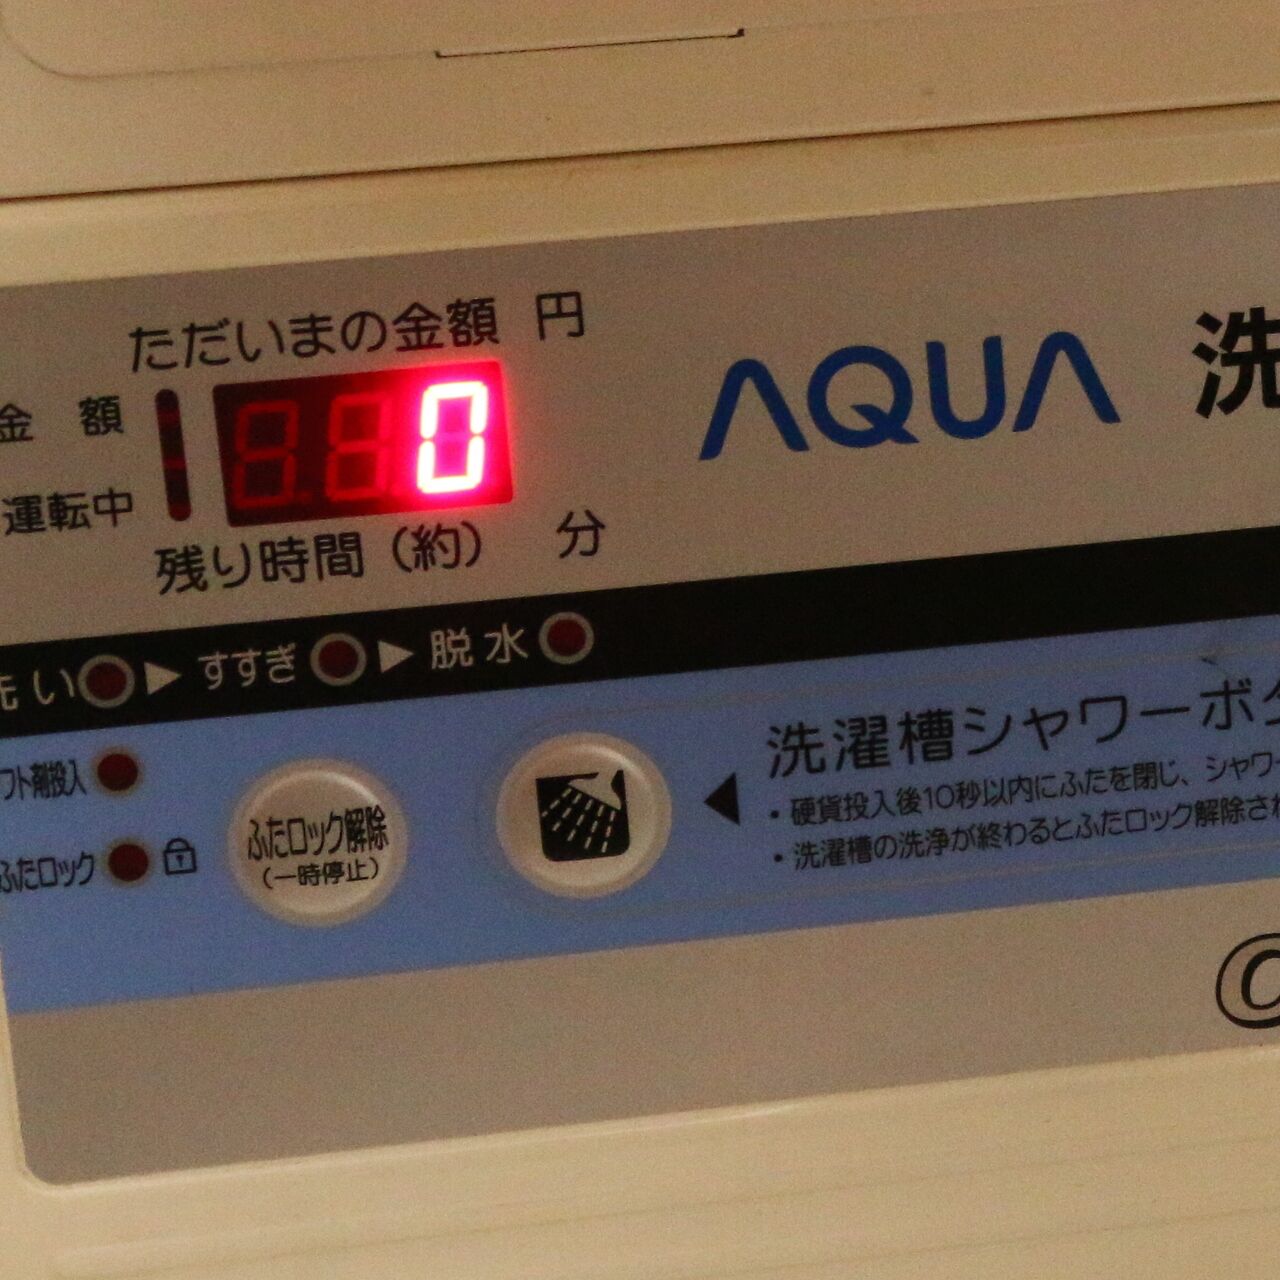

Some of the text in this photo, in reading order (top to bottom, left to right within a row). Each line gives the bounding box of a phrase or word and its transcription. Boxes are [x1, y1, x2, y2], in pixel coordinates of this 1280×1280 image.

[129, 291, 587, 373] ただいまの金額 円
[700, 331, 1121, 460] AQUA
[2, 488, 134, 536] 運転中
[556, 509, 606, 559] 分
[197, 642, 297, 691] すすぎ
[248, 804, 390, 863] ふたロック解除
[0, 850, 95, 893] ふたロック
